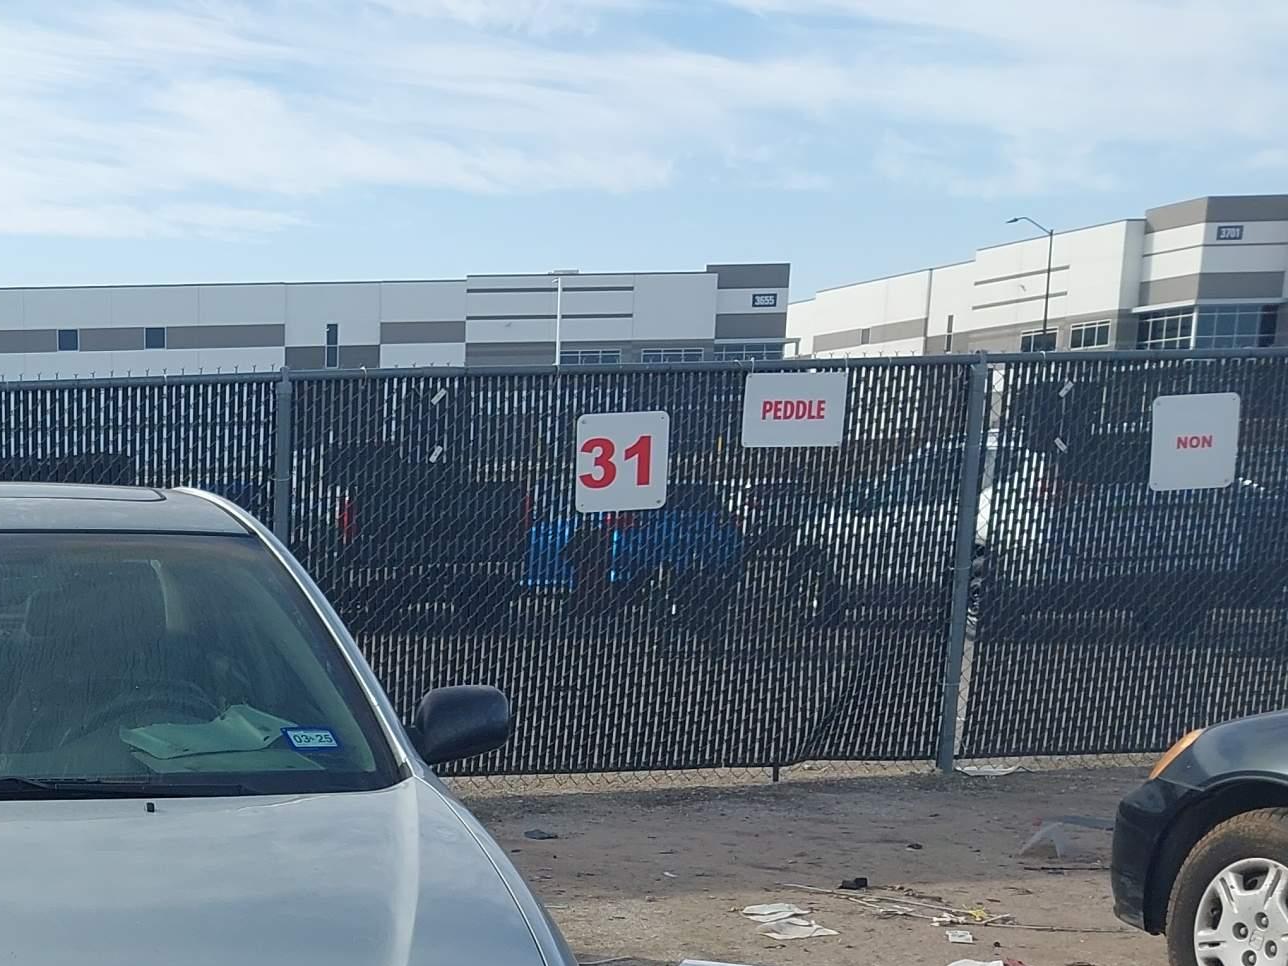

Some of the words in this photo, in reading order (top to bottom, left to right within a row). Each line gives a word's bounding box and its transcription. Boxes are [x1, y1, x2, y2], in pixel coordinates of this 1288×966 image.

[761, 400, 826, 420] PEDDLE
[1177, 435, 1213, 449] NON
[579, 435, 652, 489] 31
